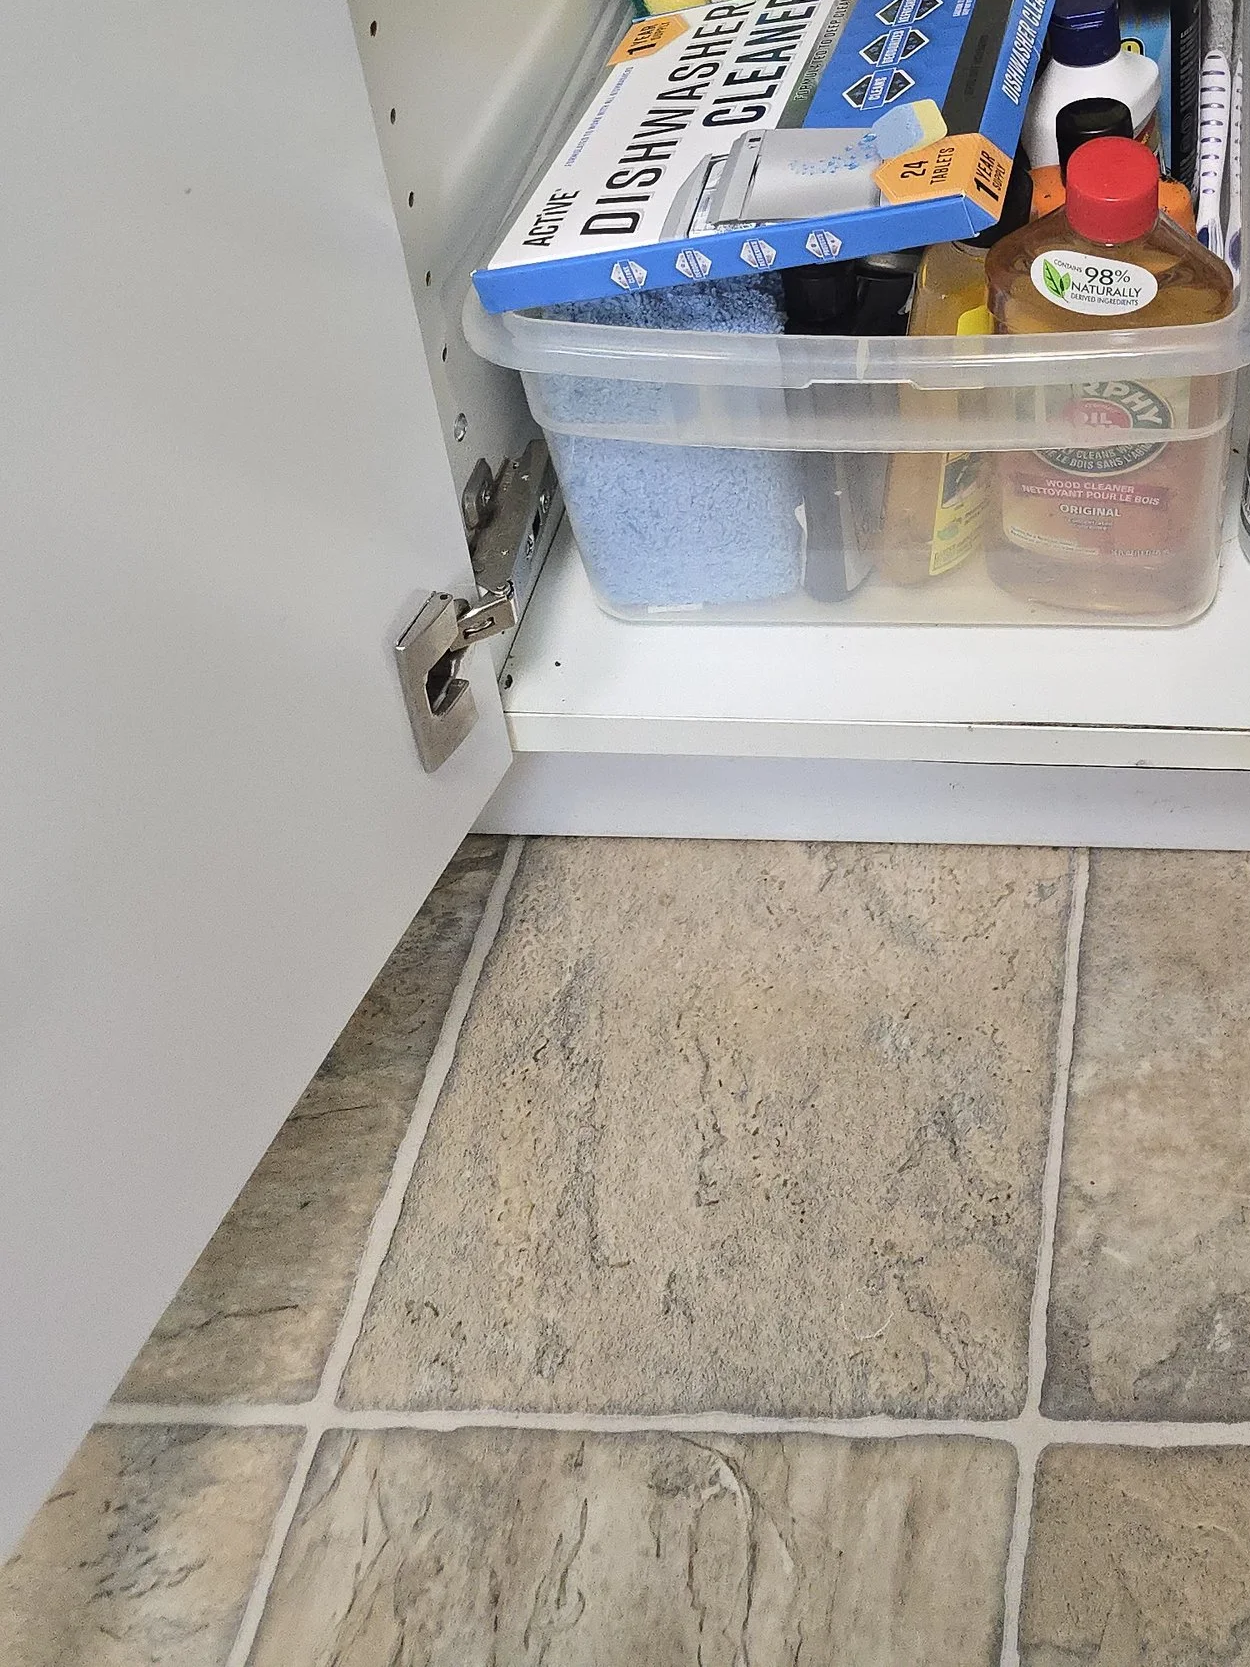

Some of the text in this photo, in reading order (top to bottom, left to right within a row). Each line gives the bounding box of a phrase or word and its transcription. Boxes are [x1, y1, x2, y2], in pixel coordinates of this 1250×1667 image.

[1001, 20, 1038, 105] DISHWASHER
[868, 75, 889, 102] CLEANS
[901, 160, 929, 179] 24
[930, 147, 955, 185] TABLETS
[974, 150, 999, 202] 1 YEAR
[522, 189, 581, 247] ACTIVE
[1053, 258, 1083, 273] CONTAINS
[1084, 266, 1131, 286] 98%
[1071, 281, 1142, 298] NATURALLY
[1070, 292, 1139, 307] DERIVED INGREDIENTS
[1055, 453, 1124, 470] LE BOIS SANS
[1021, 484, 1161, 506] NETTOYANT POUR LE BOIS
[1046, 478, 1135, 494] WOOD CLEANER
[1059, 504, 1122, 518] ORIGINAL
